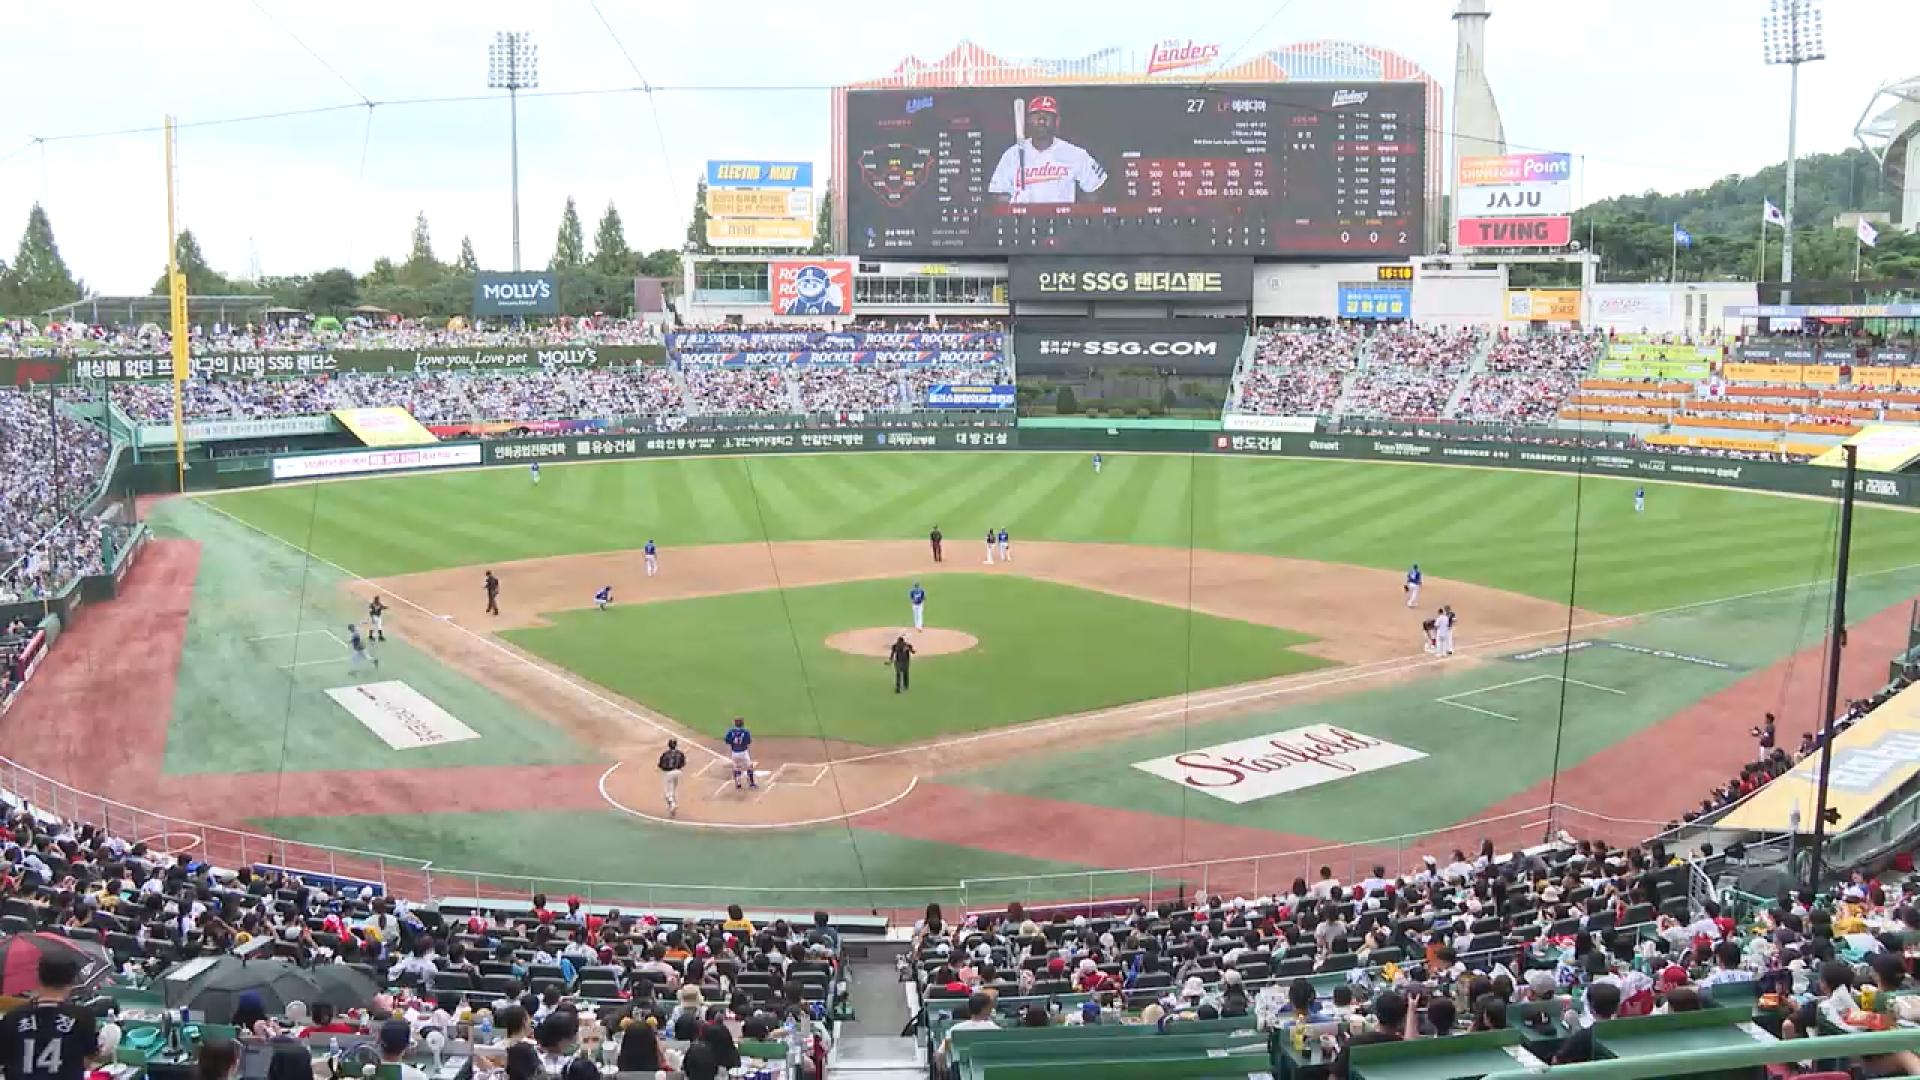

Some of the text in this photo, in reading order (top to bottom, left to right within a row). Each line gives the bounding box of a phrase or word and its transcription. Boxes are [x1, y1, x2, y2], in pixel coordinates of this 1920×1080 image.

[1147, 40, 1220, 74] Landers
[1187, 98, 1205, 112] 27
[1523, 159, 1567, 178] Point
[1486, 192, 1541, 208] JAJU
[1340, 230, 1409, 244] 0 0 2
[1478, 222, 1549, 241] TVING
[482, 278, 551, 300] MOLLY'S
[1039, 271, 1223, 292] 인천 SSG 랜더스필드
[1082, 340, 1217, 355] SSG.COM
[267, 355, 294, 371] SSG
[296, 353, 338, 371] 랜더스
[415, 348, 598, 368] Love you, Love pet MOLLY'S
[956, 432, 1008, 445] 대방건설
[1232, 436, 1282, 451] 반도건설
[1442, 448, 1489, 457] STARBUCKS
[1520, 452, 1567, 463] STARBUCKS
[1175, 729, 1380, 786] Starfield
[23, 1038, 63, 1074] 14
